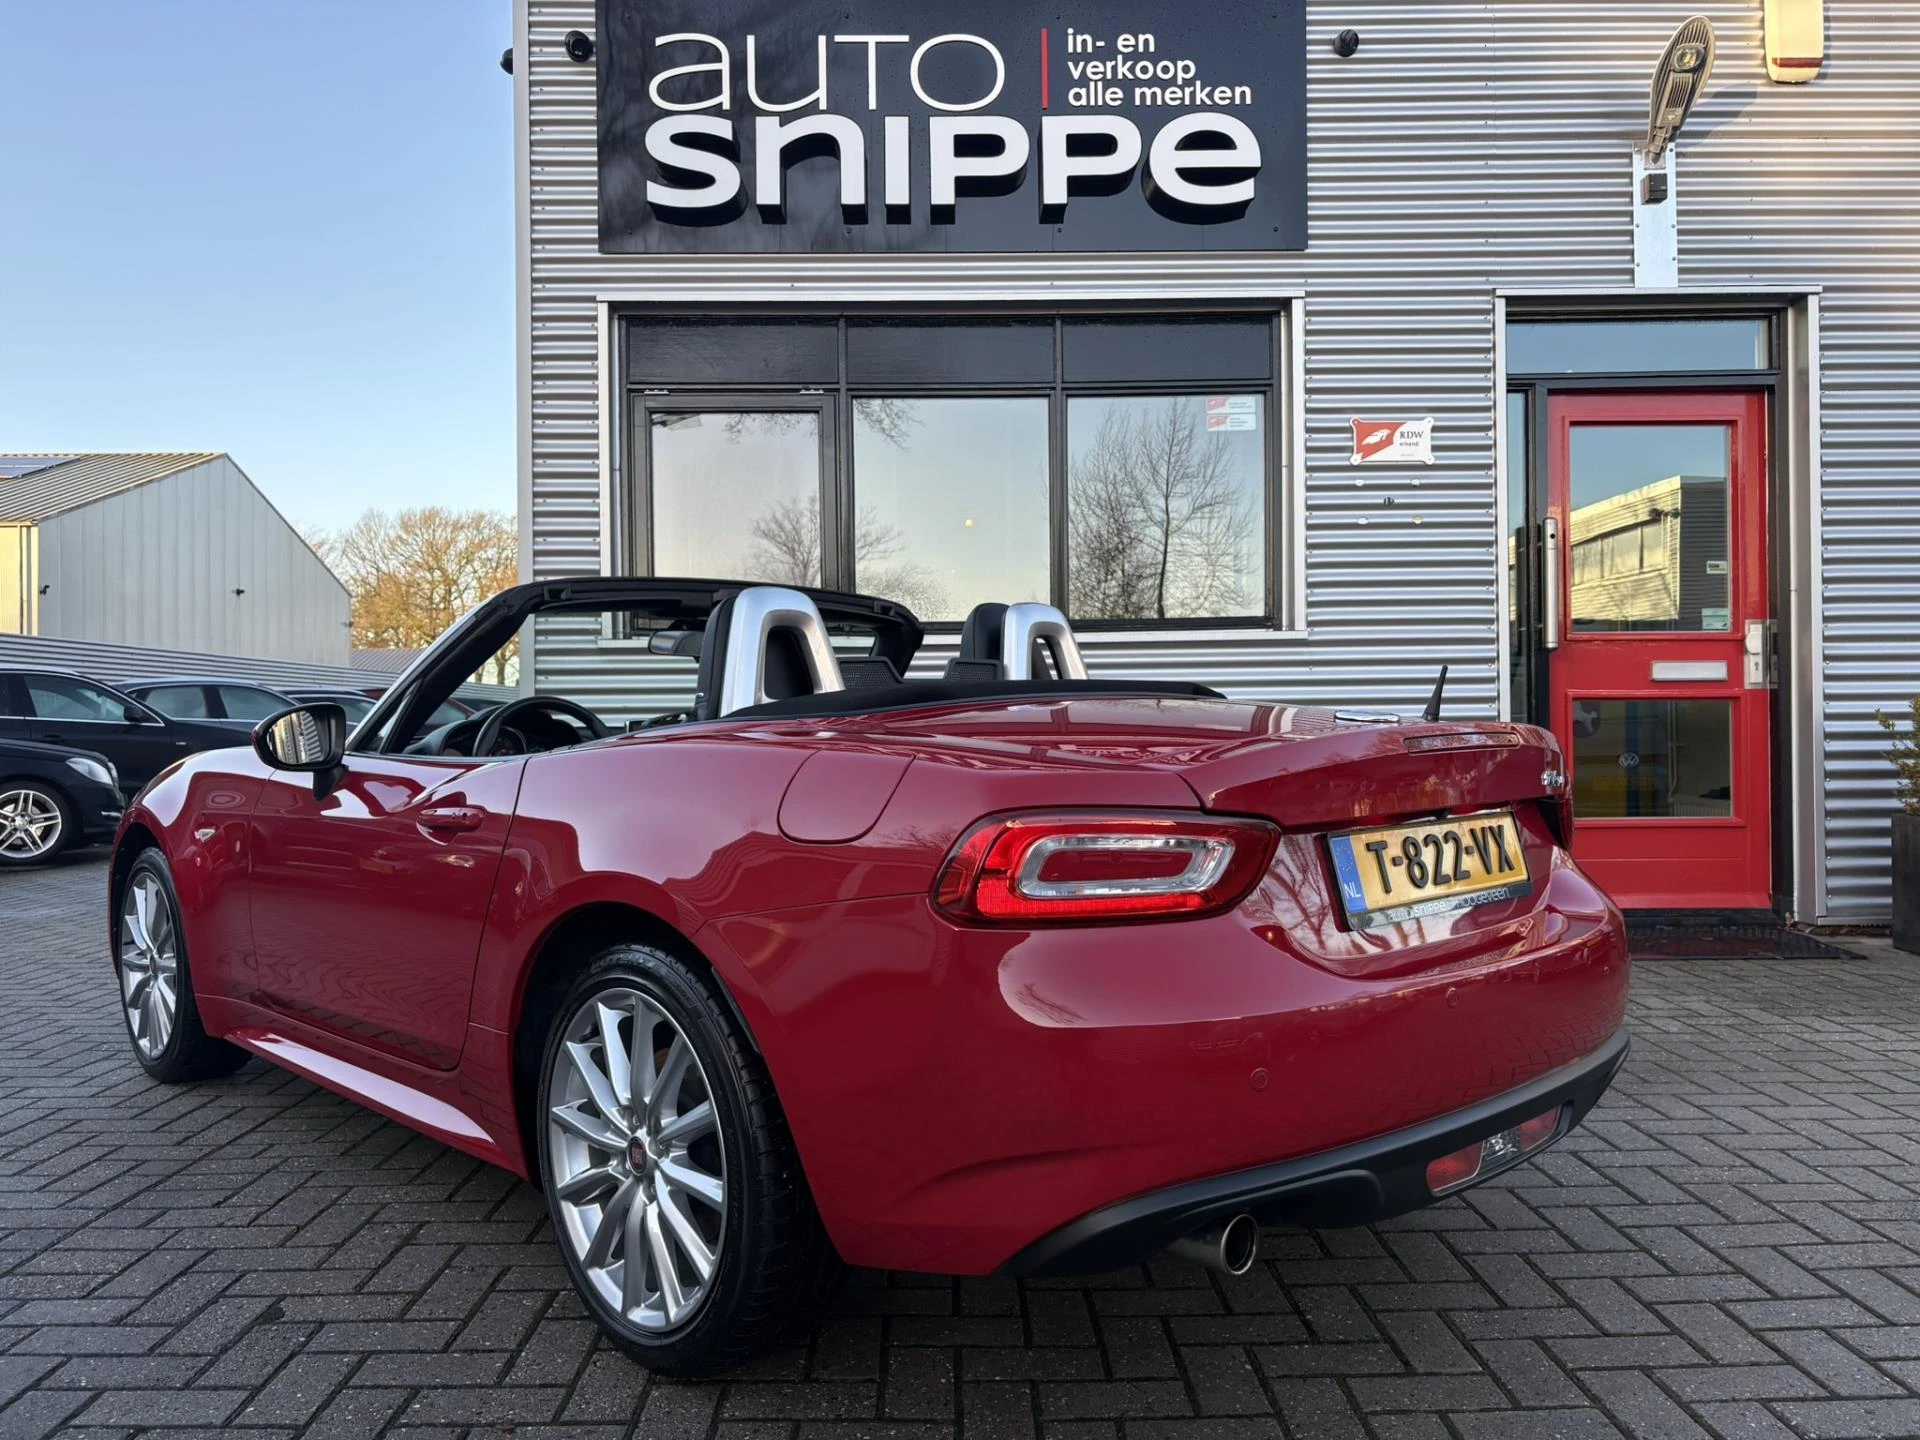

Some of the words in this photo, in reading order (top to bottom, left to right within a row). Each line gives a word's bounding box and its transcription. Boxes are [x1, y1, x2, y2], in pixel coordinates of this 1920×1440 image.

[1067, 28, 1105, 53] in-
[1117, 33, 1155, 52] en
[1067, 55, 1196, 85] verkoop
[1068, 81, 1124, 106] alle
[1134, 81, 1252, 106] merken
[1400, 431, 1424, 439] RDW
[1366, 825, 1515, 894] T-822-VX
[1344, 881, 1361, 899] NL
